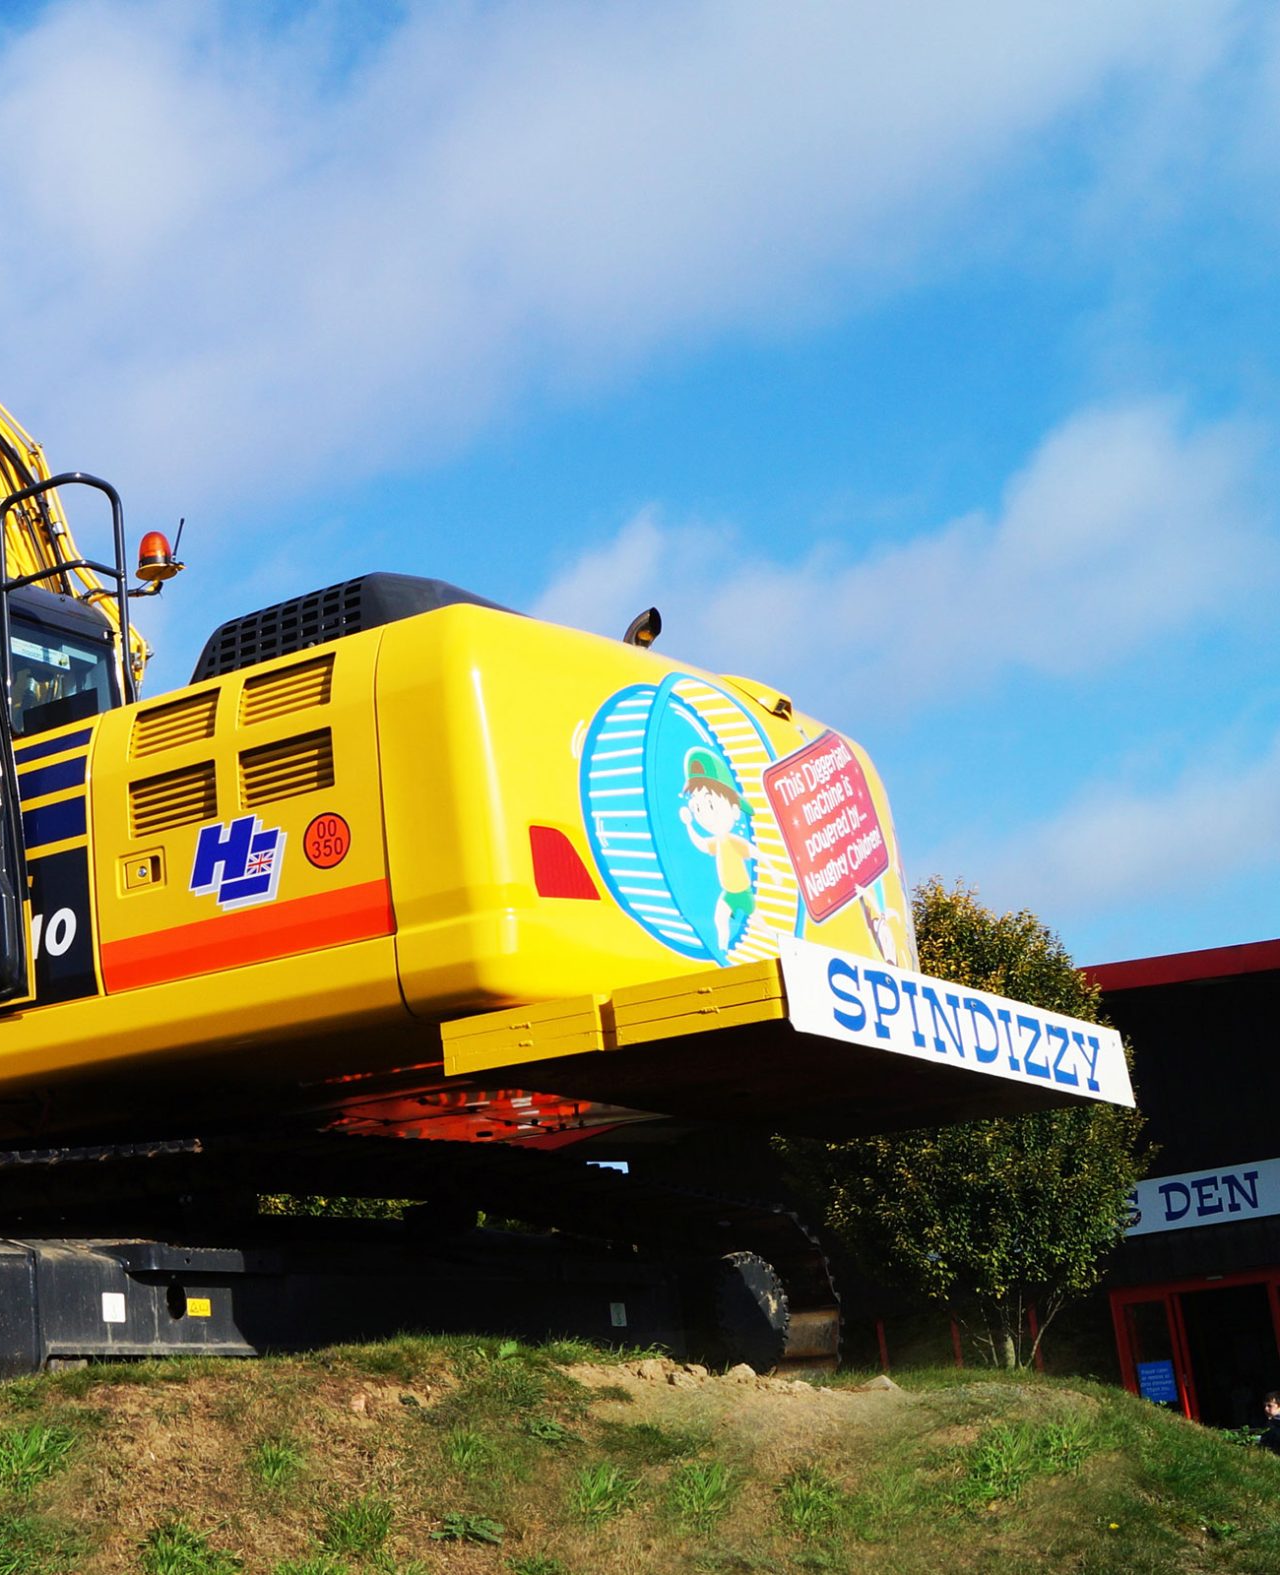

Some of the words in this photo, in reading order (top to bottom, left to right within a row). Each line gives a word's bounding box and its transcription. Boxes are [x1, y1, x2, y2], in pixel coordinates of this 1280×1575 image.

[774, 772, 805, 806] This
[801, 739, 852, 792] Diggerland
[840, 775, 854, 797] is
[312, 837, 344, 859] 350
[317, 819, 337, 839] 00
[805, 809, 852, 861] powered
[803, 848, 848, 900] Naughty
[827, 958, 1101, 1093] SPINDIZZY
[1158, 1170, 1259, 1222] DEN
